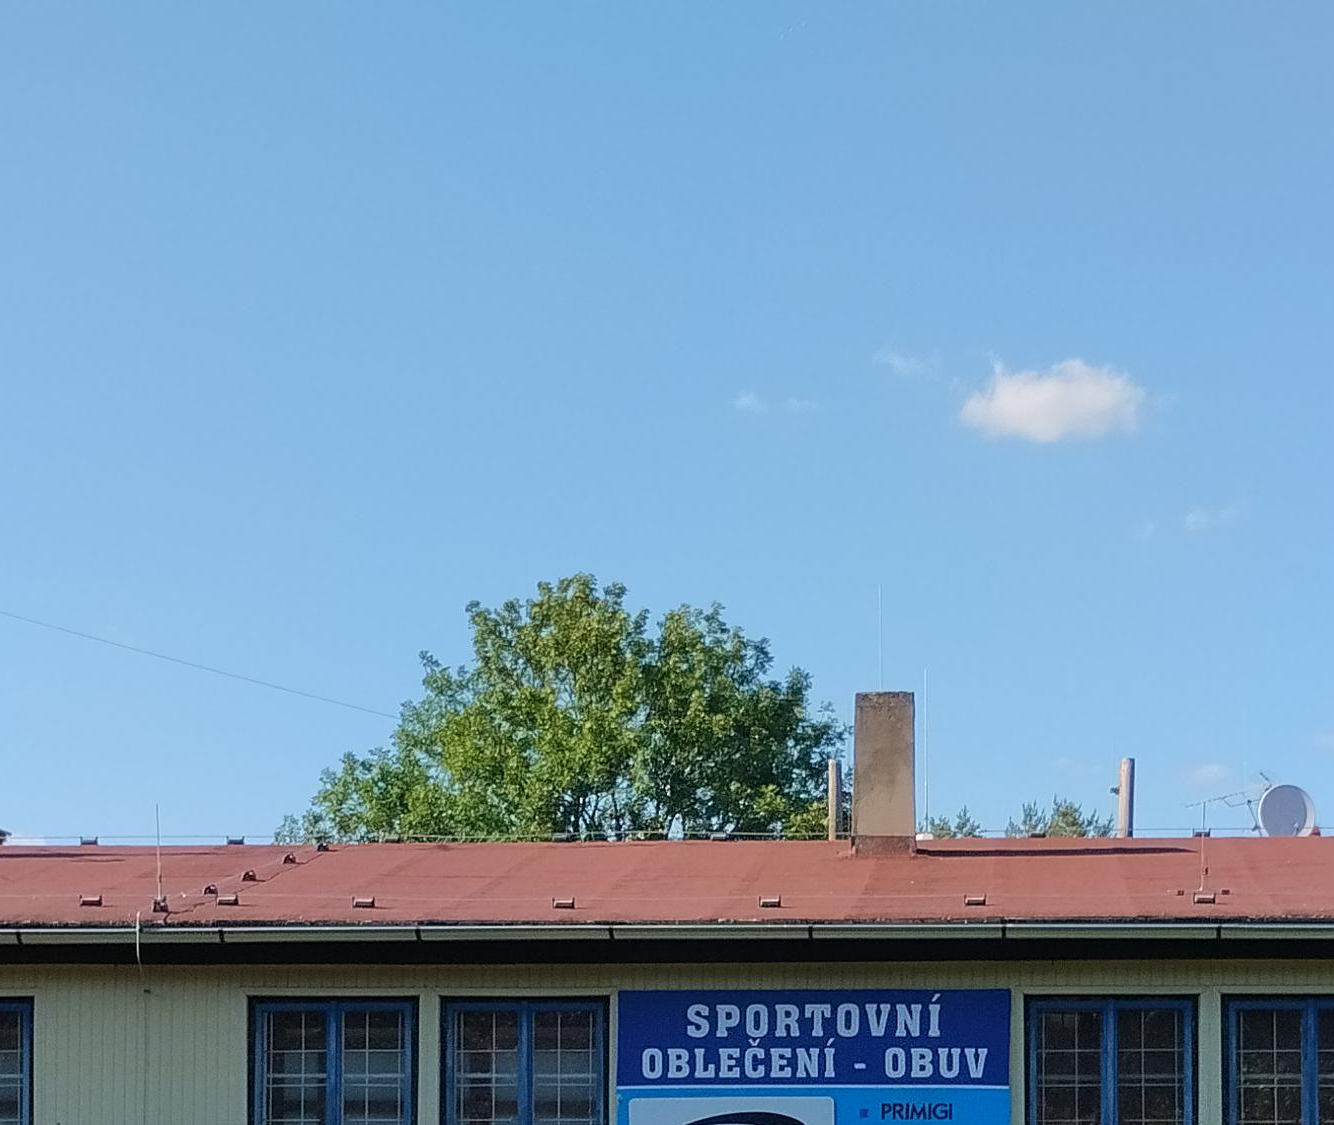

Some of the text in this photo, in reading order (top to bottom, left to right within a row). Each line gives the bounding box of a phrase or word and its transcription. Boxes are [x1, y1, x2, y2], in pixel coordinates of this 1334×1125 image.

[686, 994, 942, 1038] SPORTOVNÍ
[641, 1039, 836, 1079] OBLEČENÍ
[884, 1047, 988, 1079] OBUV
[881, 1102, 953, 1120] PRIMIGI
